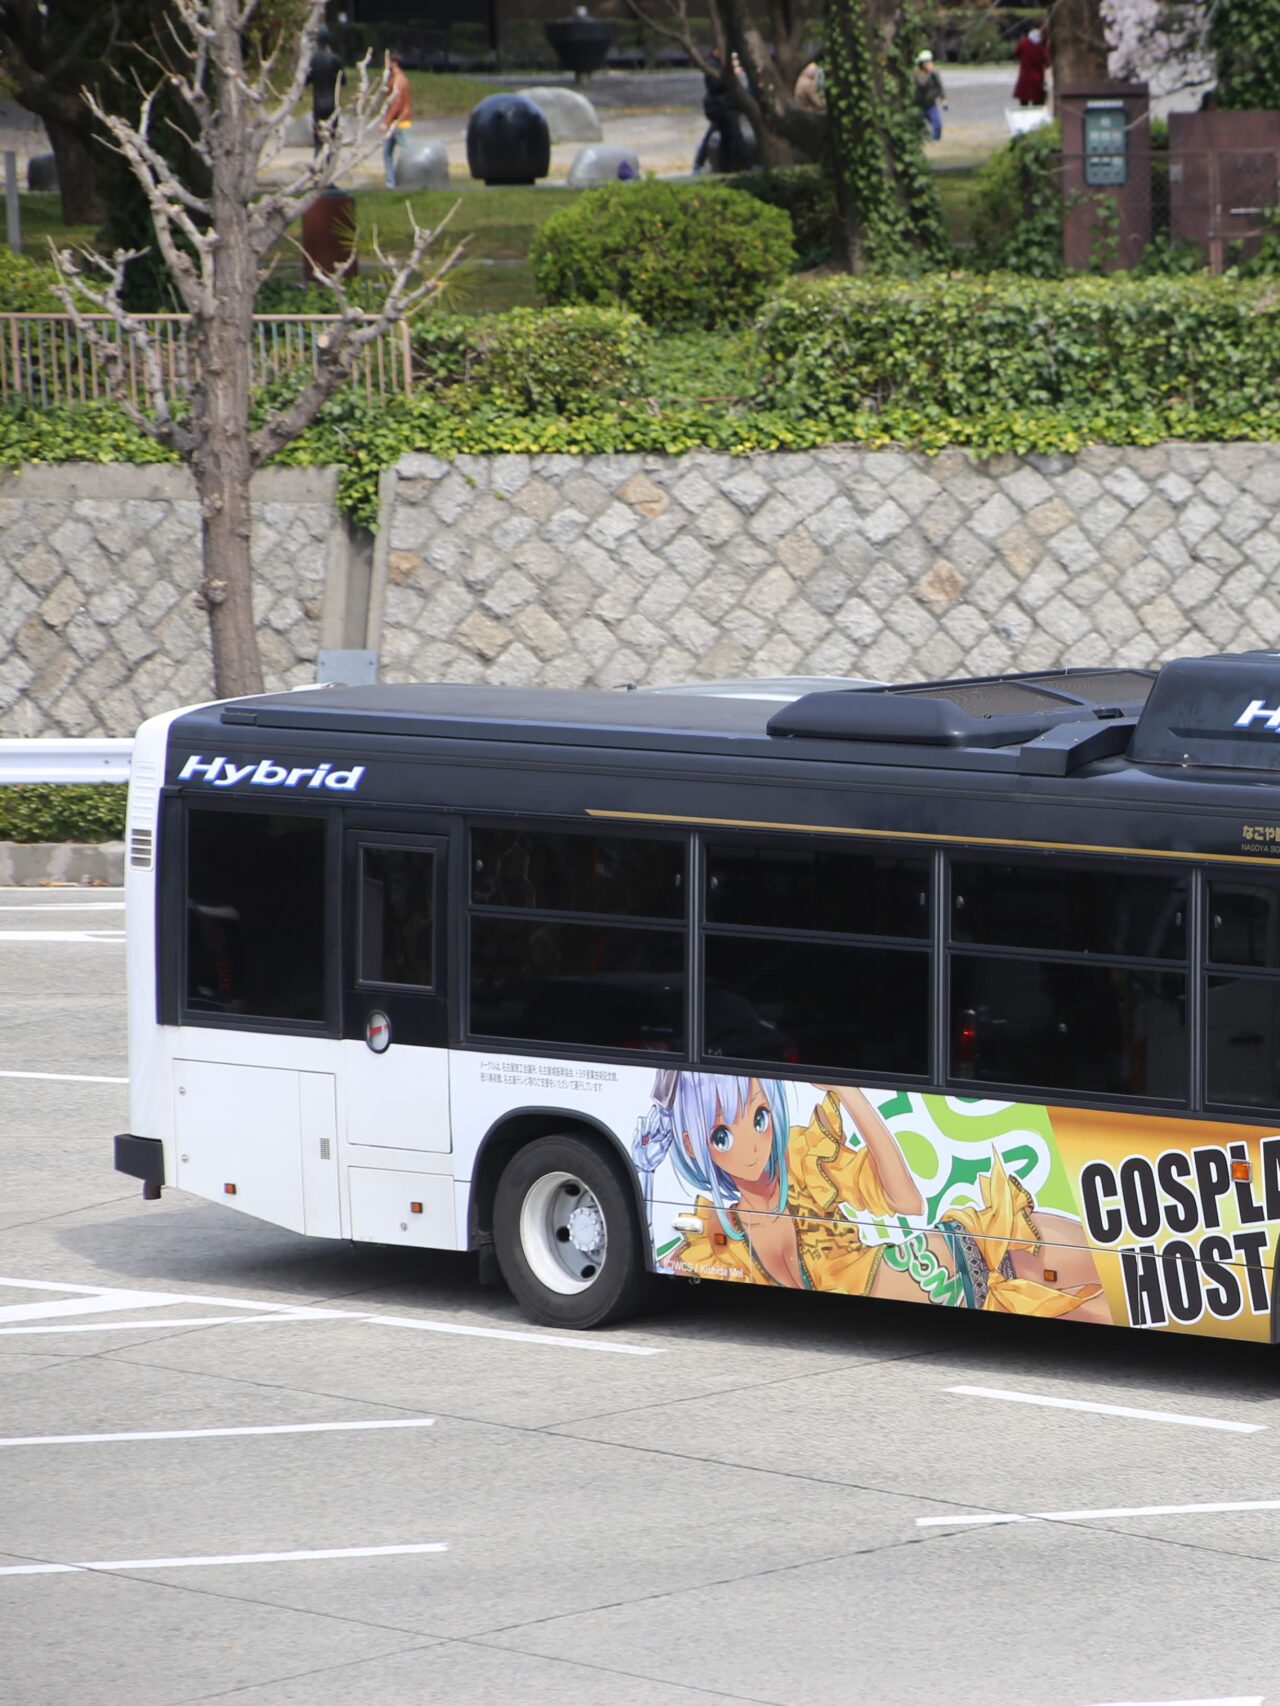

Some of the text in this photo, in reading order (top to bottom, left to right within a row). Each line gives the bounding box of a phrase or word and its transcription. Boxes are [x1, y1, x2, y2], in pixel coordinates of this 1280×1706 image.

[177, 755, 366, 791] Hybrid
[1241, 843, 1269, 852] NAGOYA
[1119, 1229, 1270, 1328] HOST
